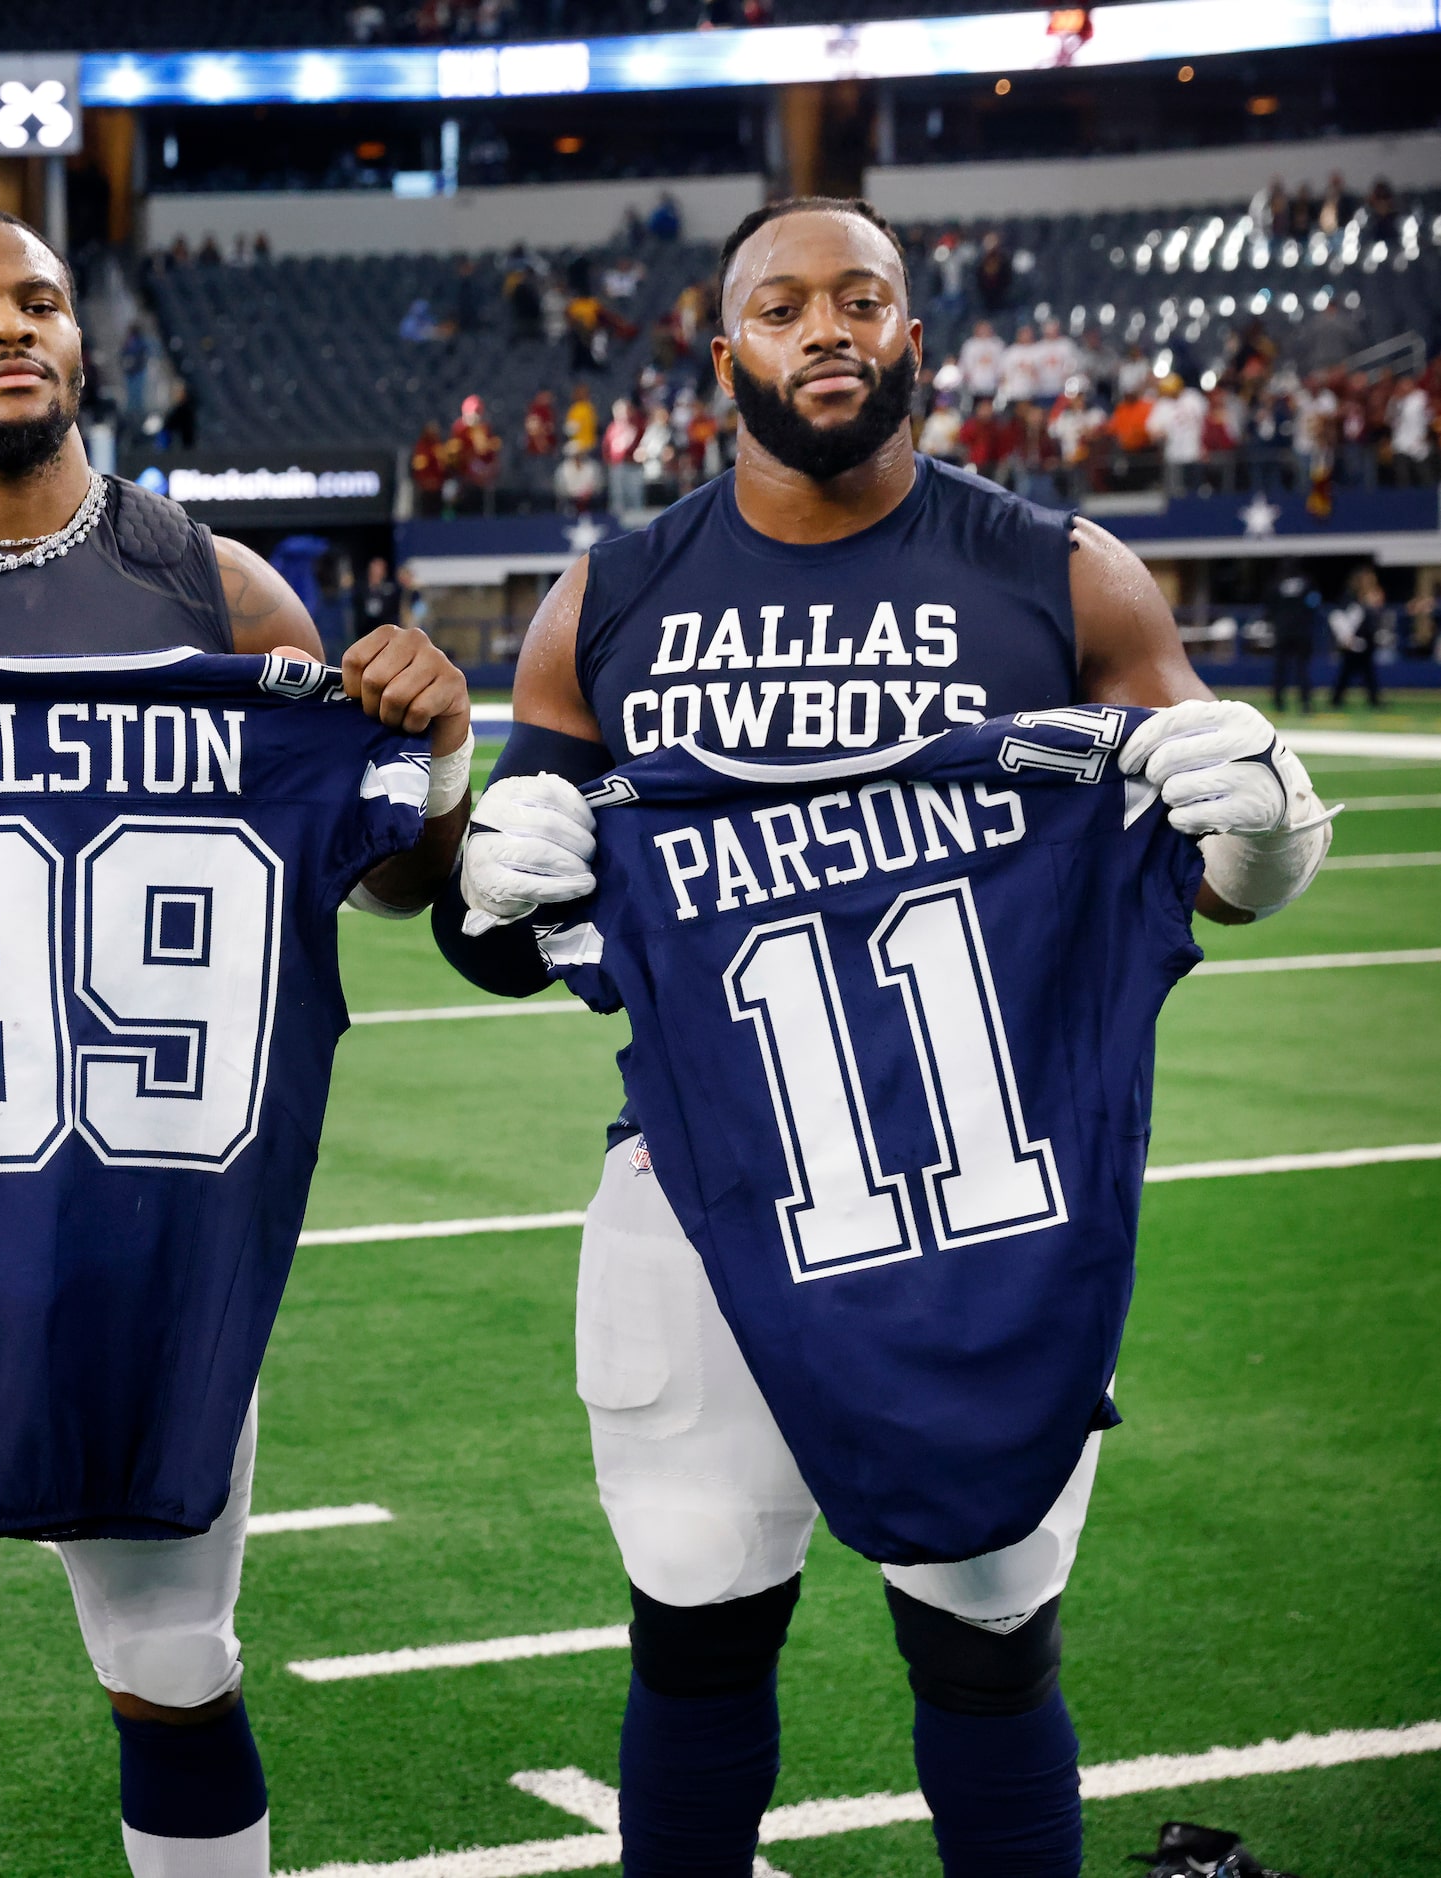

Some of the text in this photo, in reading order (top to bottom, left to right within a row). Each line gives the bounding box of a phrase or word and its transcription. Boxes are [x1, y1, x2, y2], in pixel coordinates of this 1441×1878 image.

[168, 465, 380, 501] Blockchain.com
[650, 601, 958, 676] DALLAS
[623, 680, 987, 756] COWBOYS
[997, 707, 1127, 785] 11
[652, 779, 1027, 921] PARSONS
[721, 876, 1069, 1284] 11
